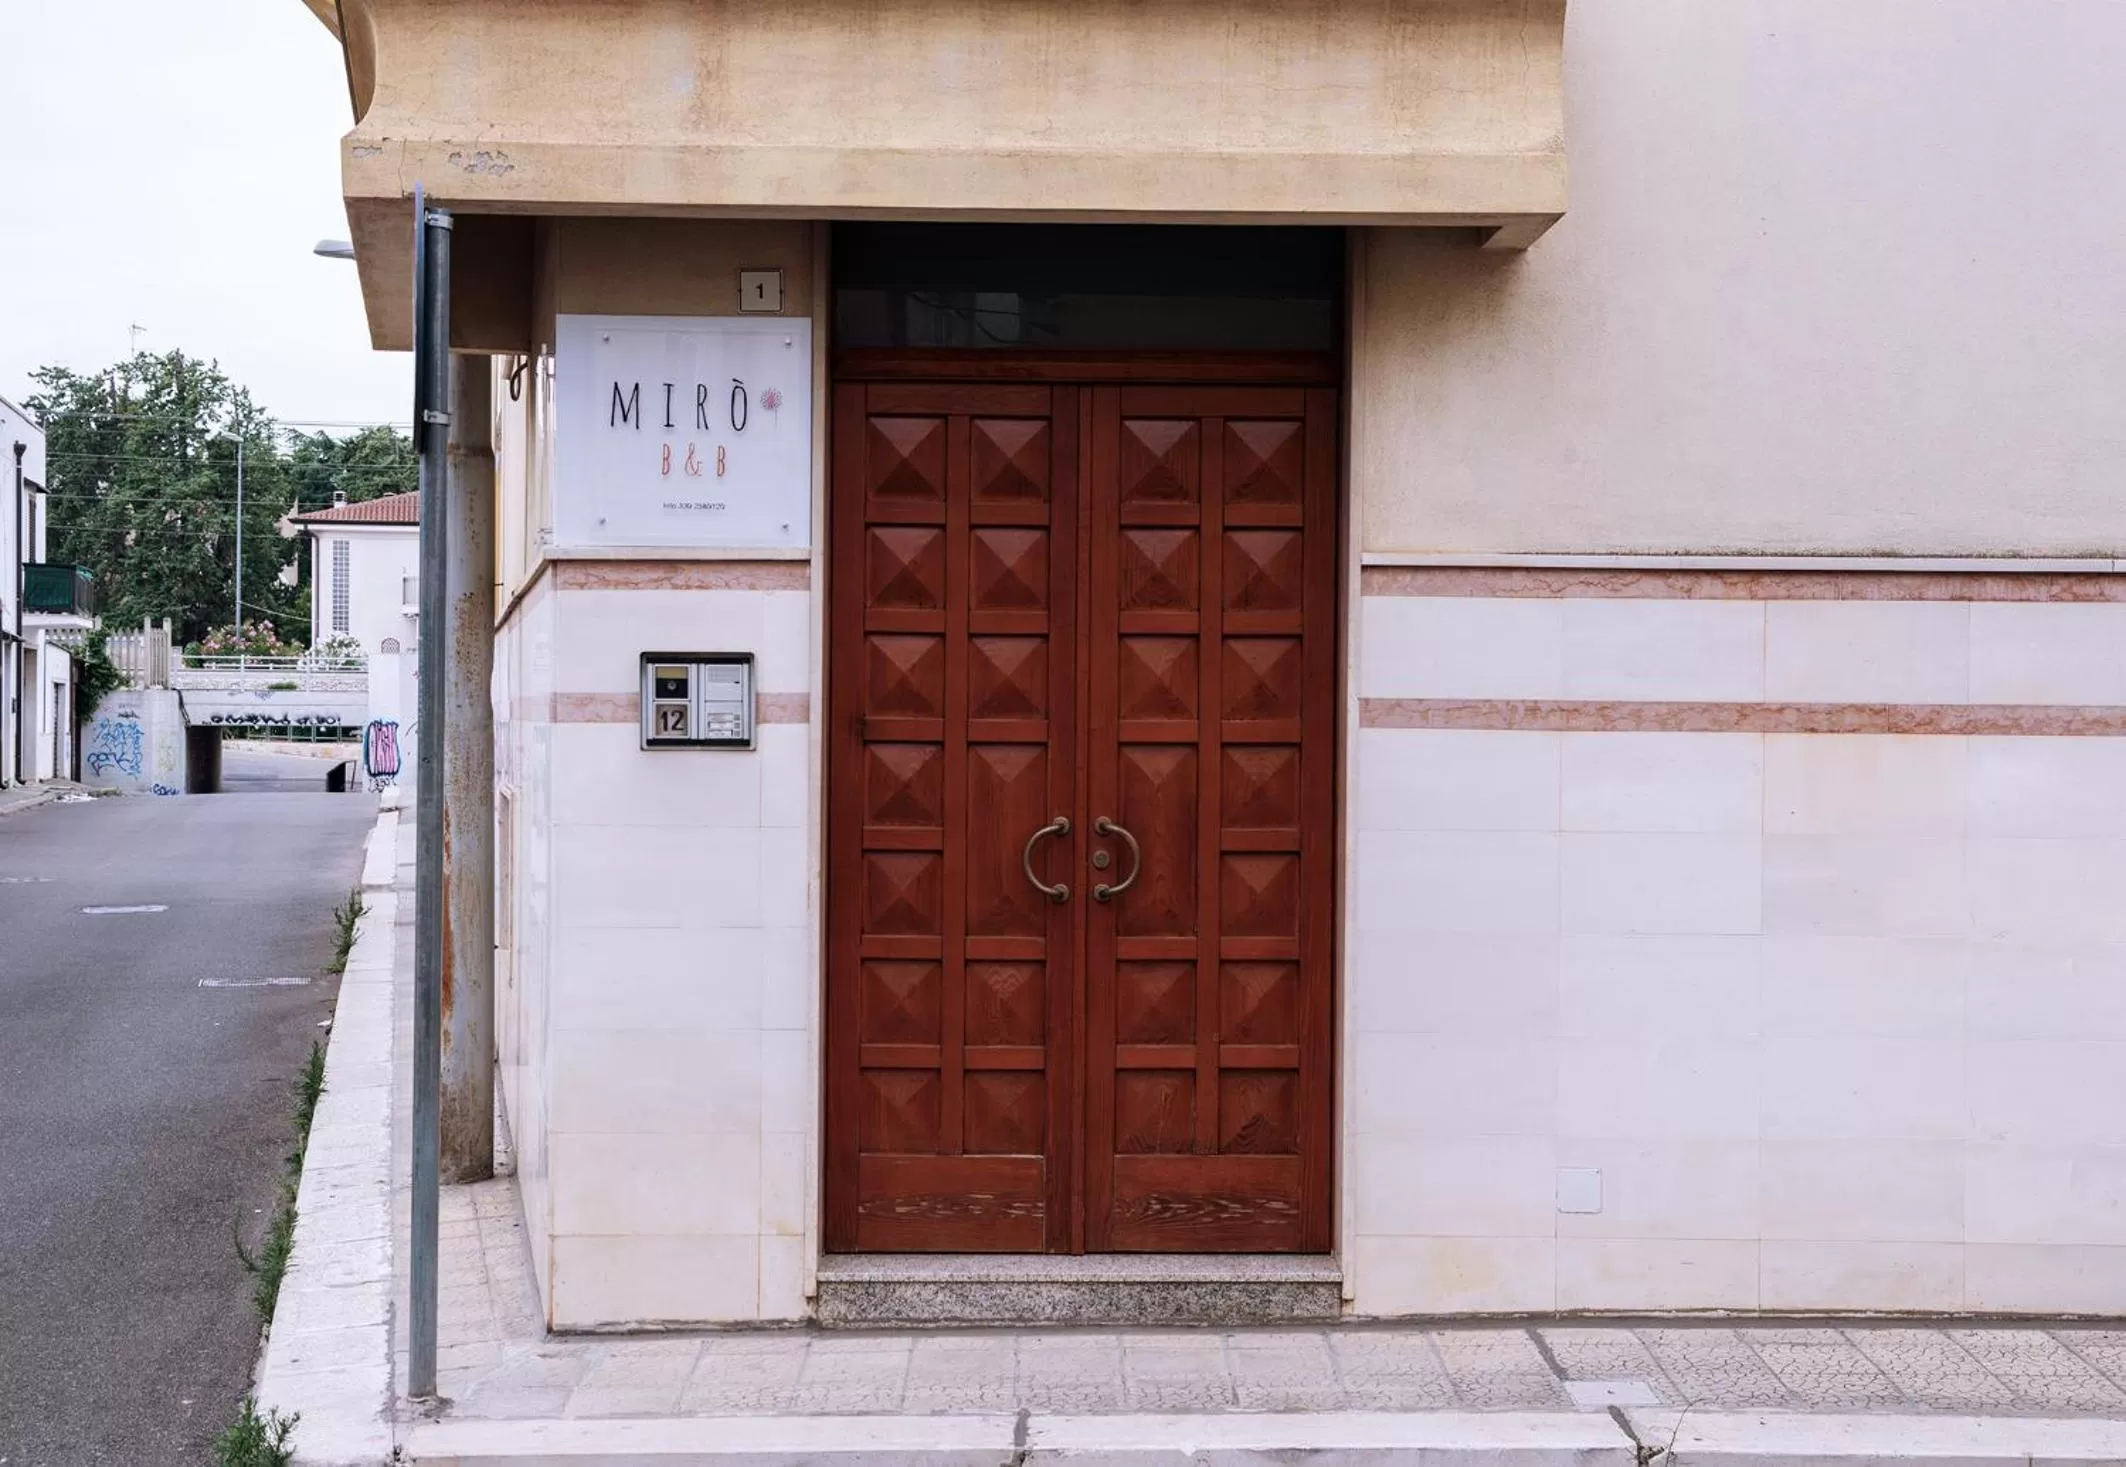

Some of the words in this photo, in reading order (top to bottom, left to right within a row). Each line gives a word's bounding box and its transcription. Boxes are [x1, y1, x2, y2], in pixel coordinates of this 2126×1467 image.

[755, 283, 764, 300] 1
[610, 378, 748, 432] MIRÒ
[660, 709, 685, 732] 12
